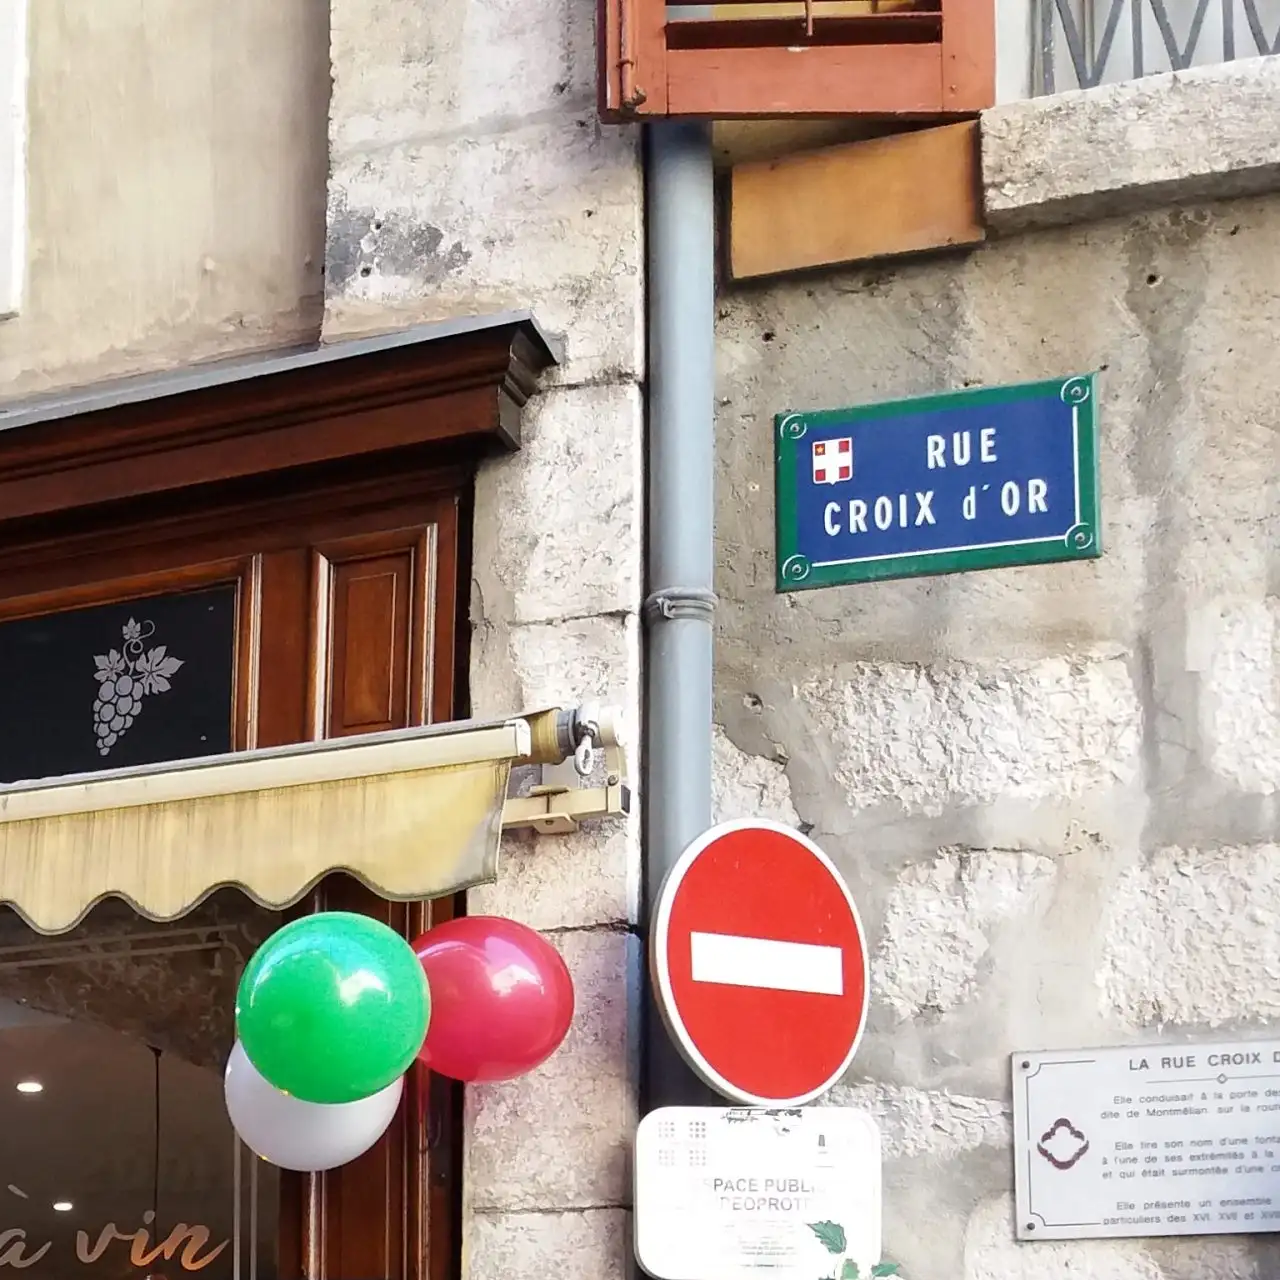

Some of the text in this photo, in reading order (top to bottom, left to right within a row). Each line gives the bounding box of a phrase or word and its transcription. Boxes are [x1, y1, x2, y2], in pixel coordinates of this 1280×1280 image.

[926, 427, 999, 471] RUE
[823, 478, 1049, 537] CROIX d'OR
[1128, 1052, 1262, 1071] LA RUE CROIX
[1113, 1095, 1133, 1105] Elle
[1139, 1092, 1194, 1104] conduisait
[1213, 1091, 1223, 1100] la
[1229, 1089, 1259, 1101] porte
[1100, 1110, 1120, 1120] dite
[1126, 1109, 1140, 1119] de
[1217, 1105, 1234, 1114] sur
[1240, 1103, 1251, 1113] la
[1114, 1136, 1248, 1151] Elle tire son nom d'une
[1114, 1155, 1139, 1165] l'une
[1144, 1154, 1158, 1164] de
[1164, 1154, 1183, 1163] ses
[1189, 1151, 1245, 1162] extrémités
[1264, 1149, 1274, 1159] la
[1101, 1170, 1113, 1180] et
[1119, 1169, 1135, 1180] qui
[1141, 1168, 1166, 1179] était
[1172, 1165, 1228, 1177] surmontée
[1234, 1163, 1265, 1175] d'une
[705, 1177, 759, 1194] PACE
[1116, 1196, 1272, 1211] Elle présente un ensemble
[1103, 1211, 1255, 1227] particuliers des et
[76, 1210, 231, 1271] vin
